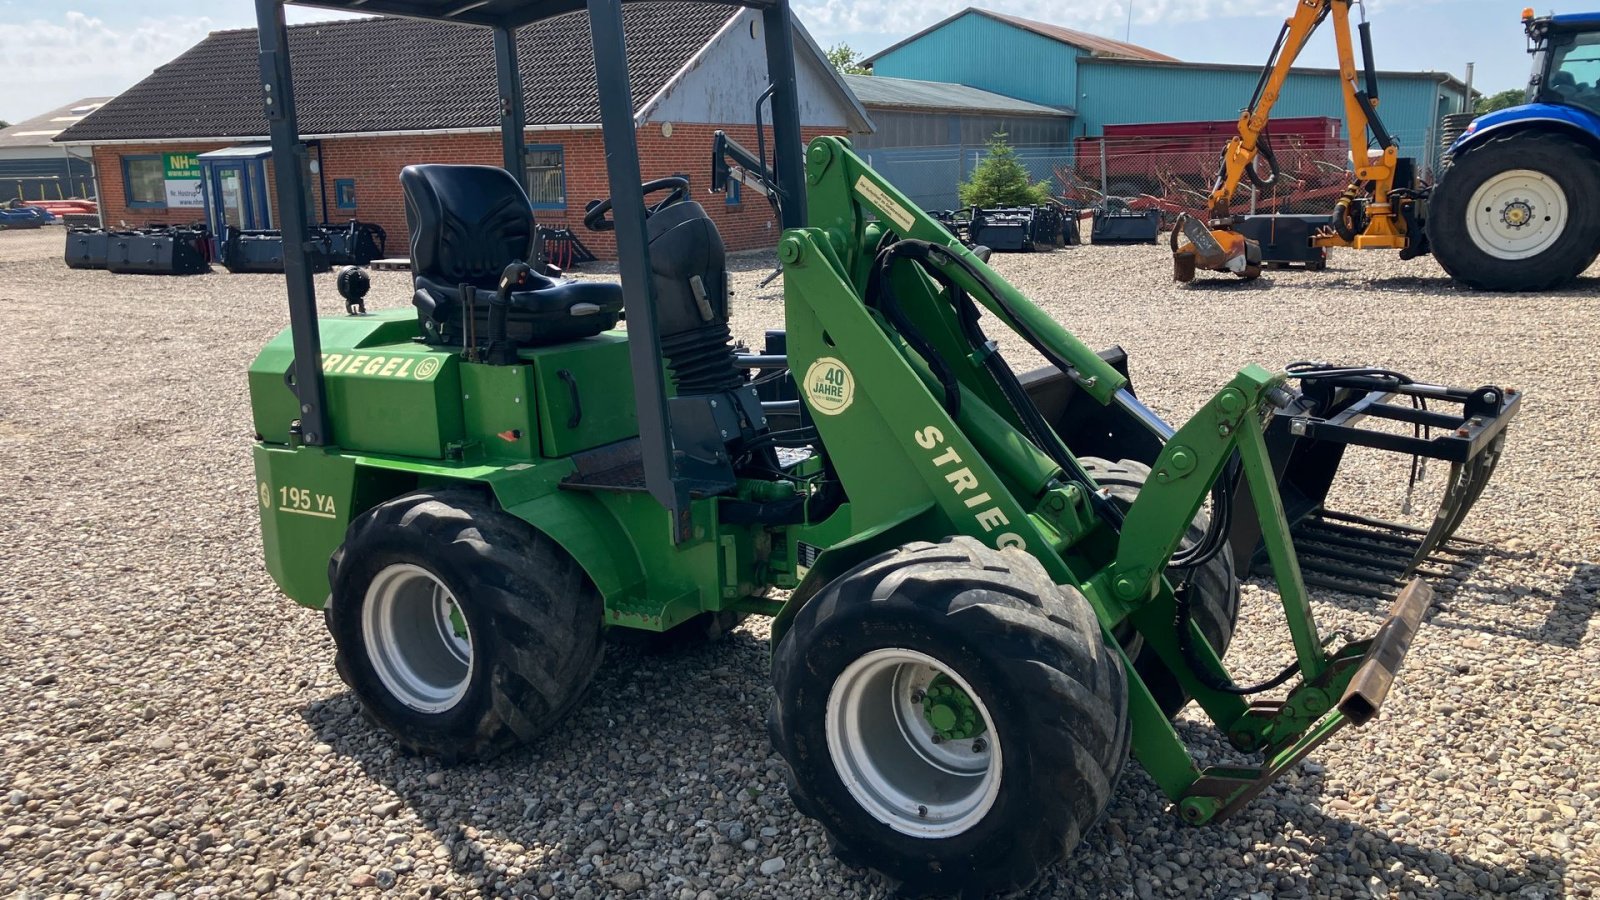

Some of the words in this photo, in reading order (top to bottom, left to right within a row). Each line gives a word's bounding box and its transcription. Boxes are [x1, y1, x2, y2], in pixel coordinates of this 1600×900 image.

[170, 155, 189, 169] NH
[320, 353, 415, 378] RIEGEL
[825, 367, 844, 386] 40
[813, 383, 843, 398] JAHRE
[280, 486, 311, 510] 195
[316, 494, 336, 513] YA
